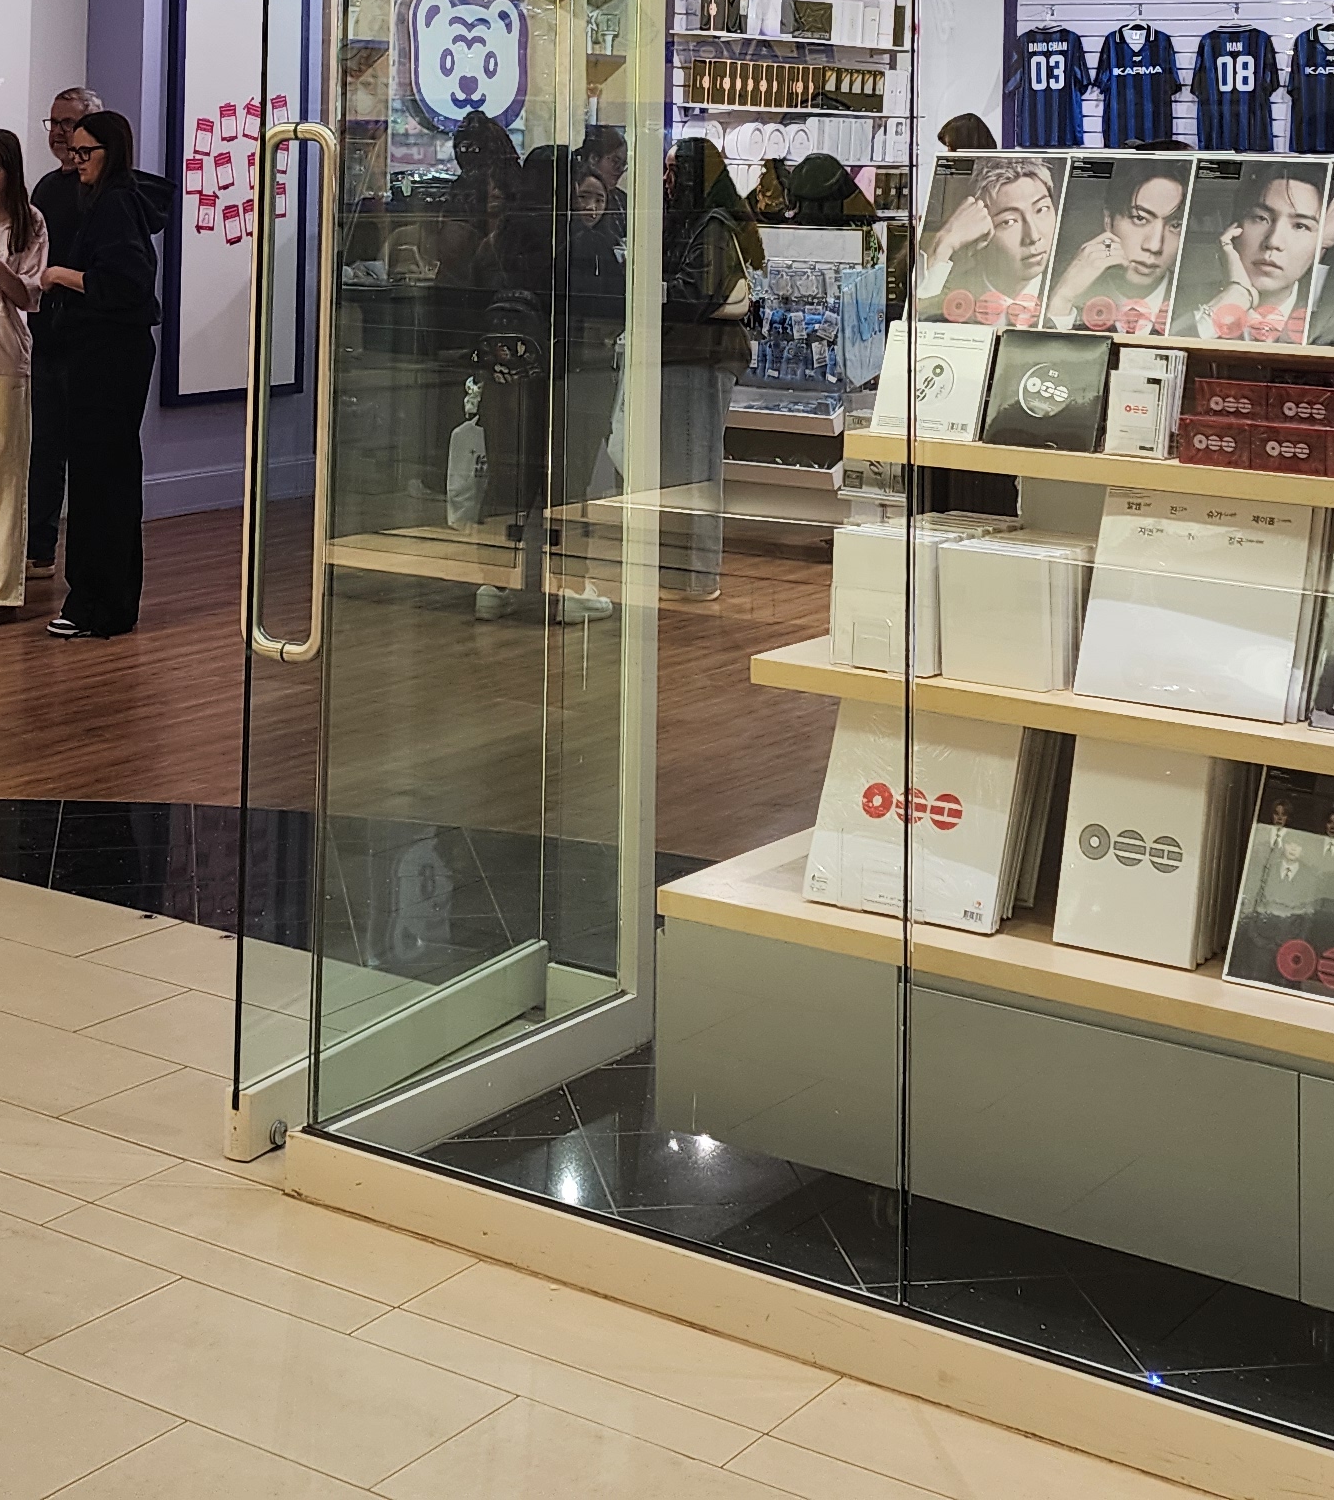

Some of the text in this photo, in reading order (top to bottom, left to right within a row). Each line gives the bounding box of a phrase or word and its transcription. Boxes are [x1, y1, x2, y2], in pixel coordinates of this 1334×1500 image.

[1031, 55, 1065, 91] 03
[1112, 66, 1163, 76] KARMA
[1217, 56, 1255, 92] 08
